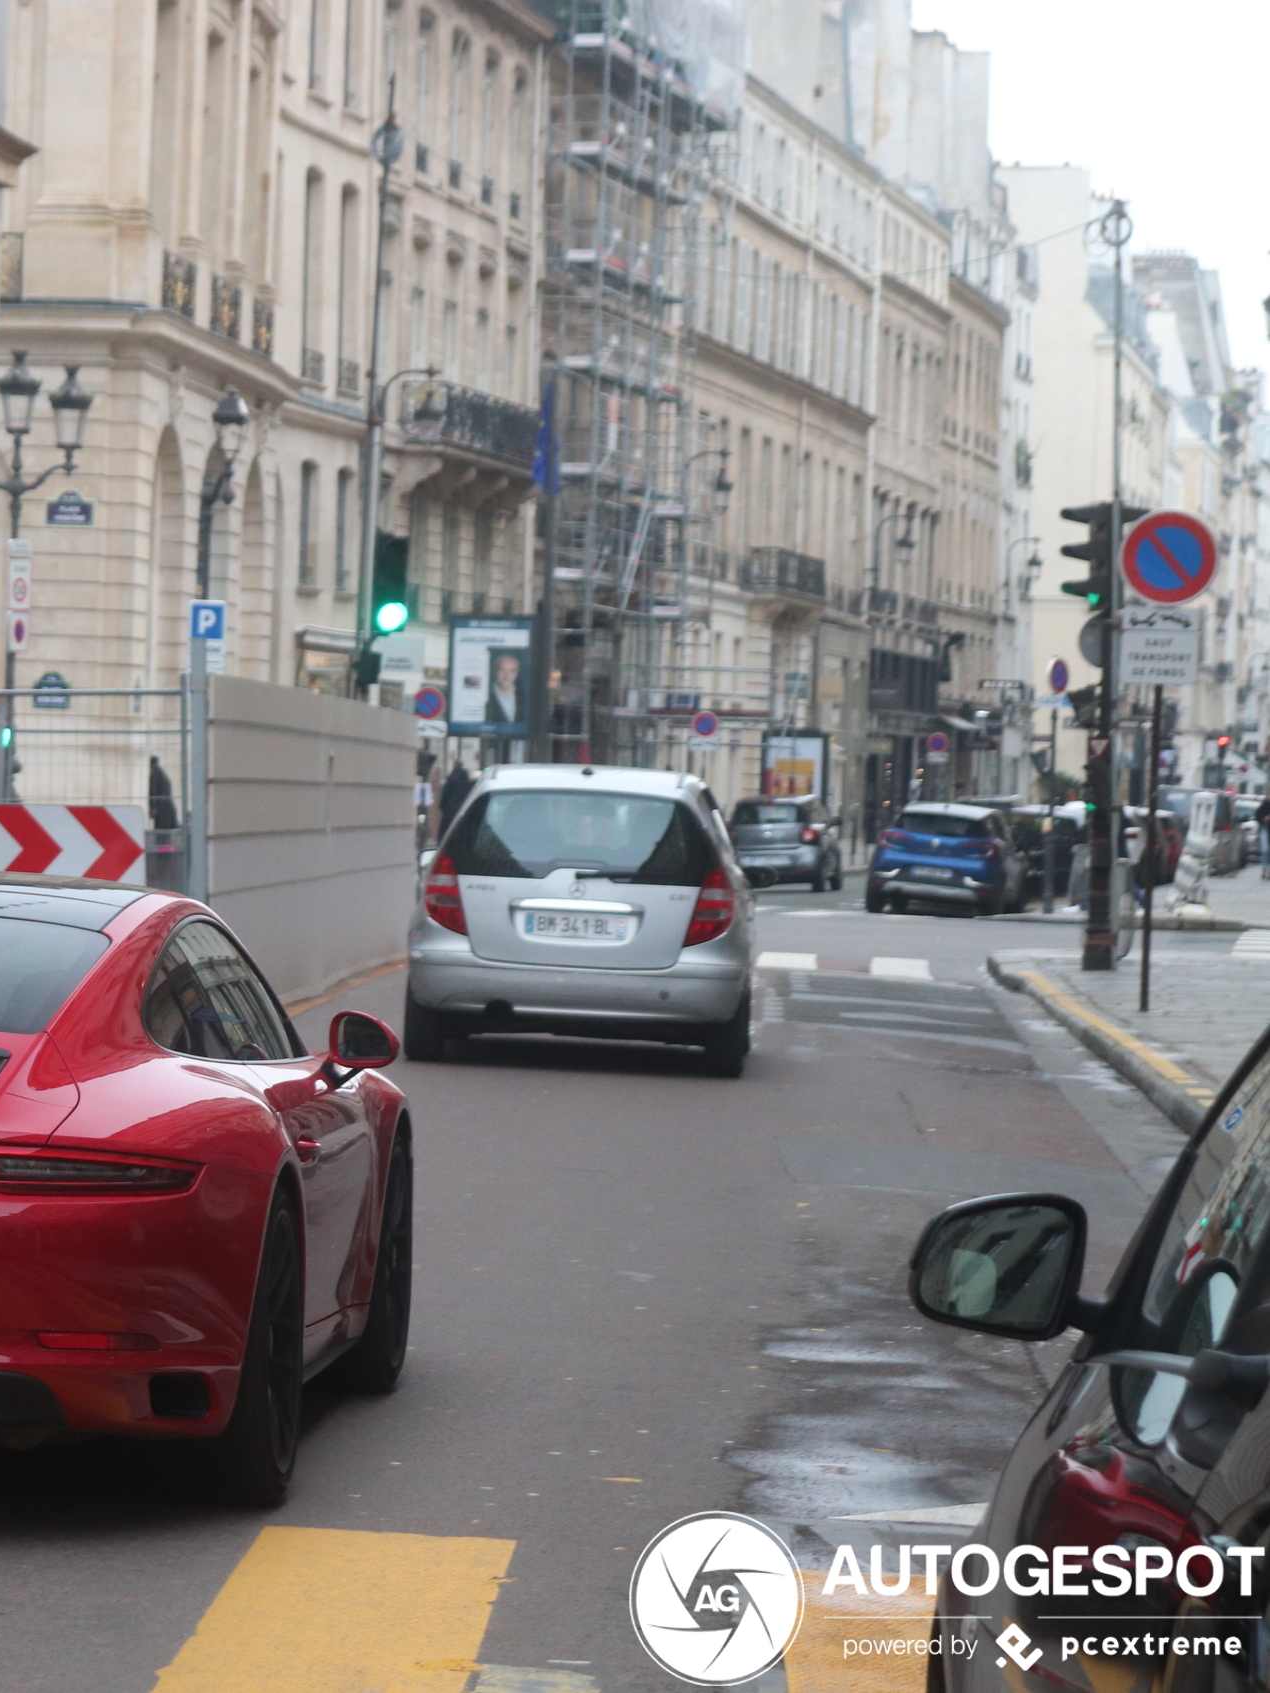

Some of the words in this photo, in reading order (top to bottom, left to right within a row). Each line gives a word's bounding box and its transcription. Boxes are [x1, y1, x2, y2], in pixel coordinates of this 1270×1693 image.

[197, 608, 216, 634] P
[1145, 637, 1173, 647] SAUF
[1128, 651, 1192, 661] TRANSPORT
[1132, 666, 1146, 676] DE
